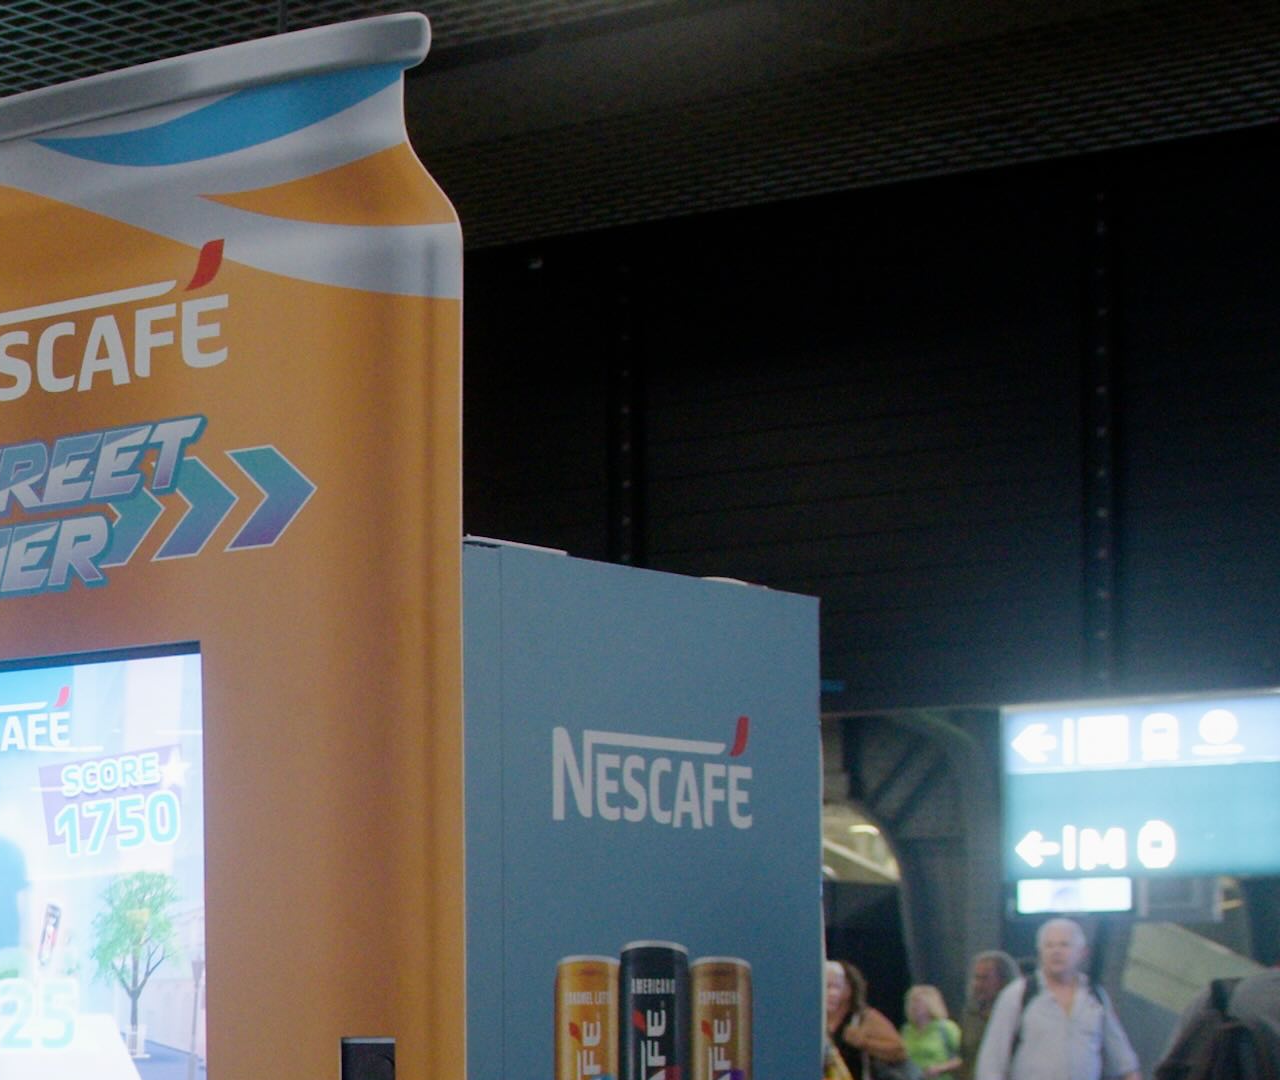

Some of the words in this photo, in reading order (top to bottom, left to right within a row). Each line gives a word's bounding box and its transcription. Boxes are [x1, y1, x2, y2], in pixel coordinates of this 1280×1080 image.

[60, 752, 162, 797] SCORE
[552, 716, 753, 830] NESCAFÉ
[53, 789, 183, 857] 1750
